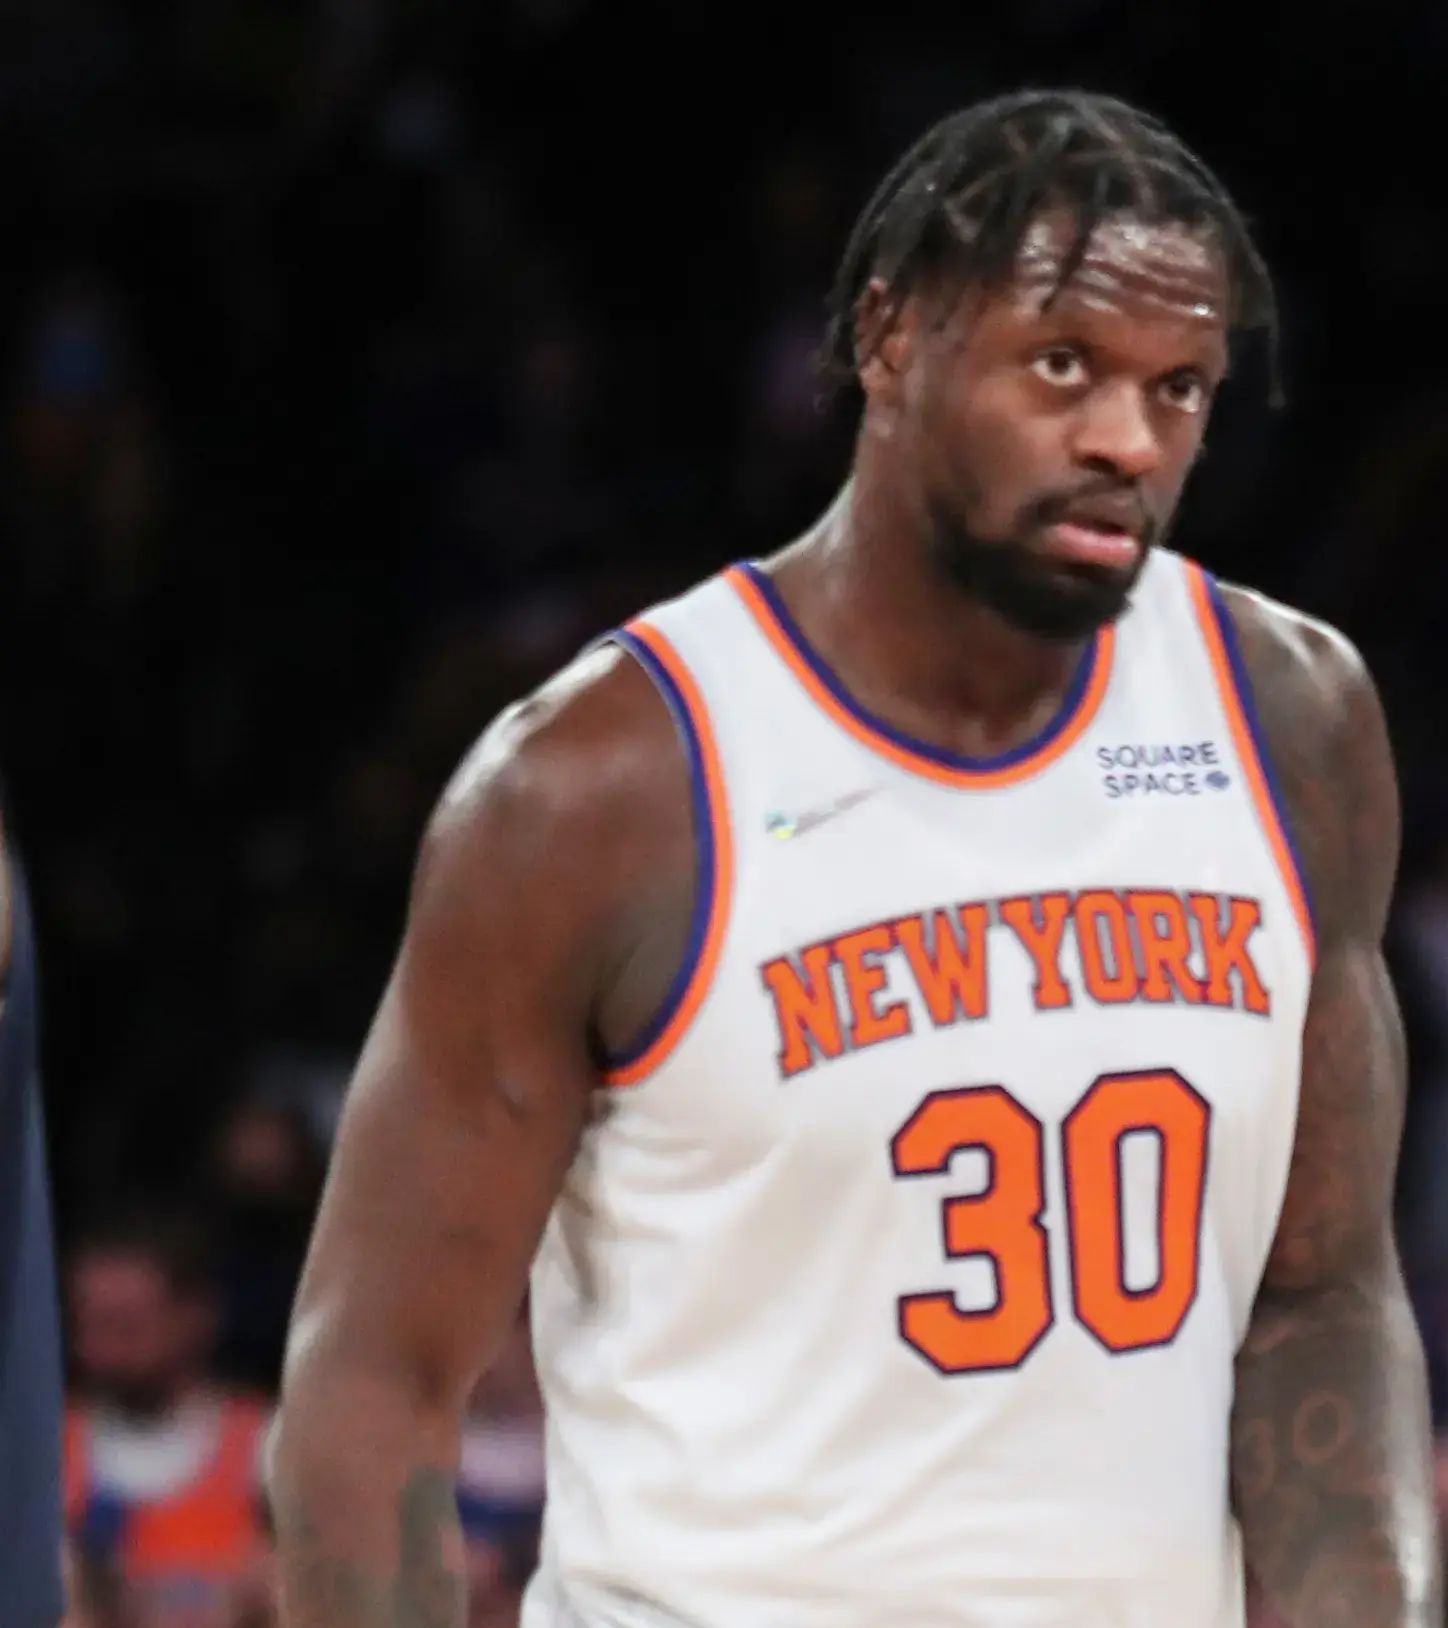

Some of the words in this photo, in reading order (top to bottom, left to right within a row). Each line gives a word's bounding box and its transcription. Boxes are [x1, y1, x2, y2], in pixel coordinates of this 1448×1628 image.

[1097, 740, 1219, 770] SQUARE
[1104, 772, 1201, 798] SPACE
[758, 901, 990, 1081] NEW
[1000, 888, 1271, 1018] YORK
[889, 1067, 1212, 1375] 30
